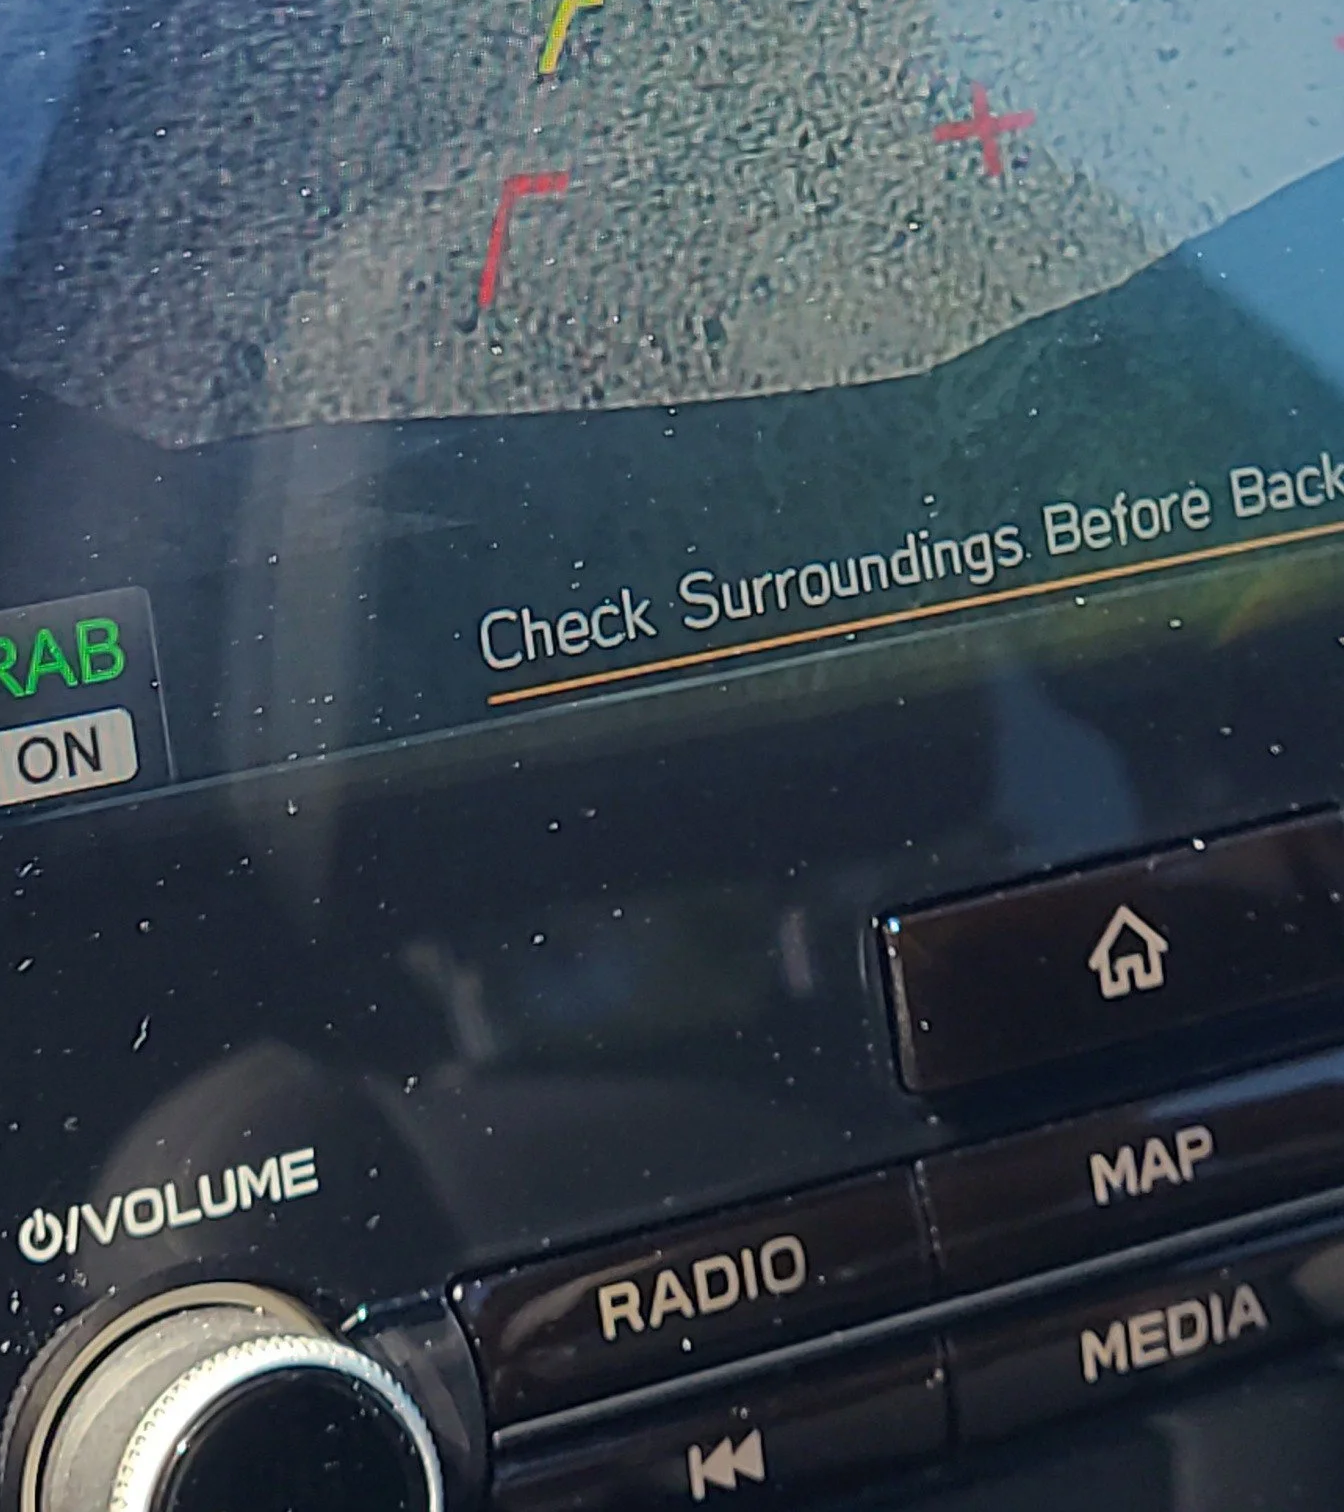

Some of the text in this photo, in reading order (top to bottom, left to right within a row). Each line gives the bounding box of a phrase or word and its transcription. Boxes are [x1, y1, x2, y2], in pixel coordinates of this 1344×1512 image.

[478, 586, 657, 672] Check
[677, 522, 1026, 632] Surroundings
[1040, 486, 1213, 559] Before
[17, 725, 103, 785] ON
[1087, 1125, 1218, 1208] MAP
[596, 1231, 810, 1342] RADIO
[1077, 1282, 1271, 1384] MEDIA
